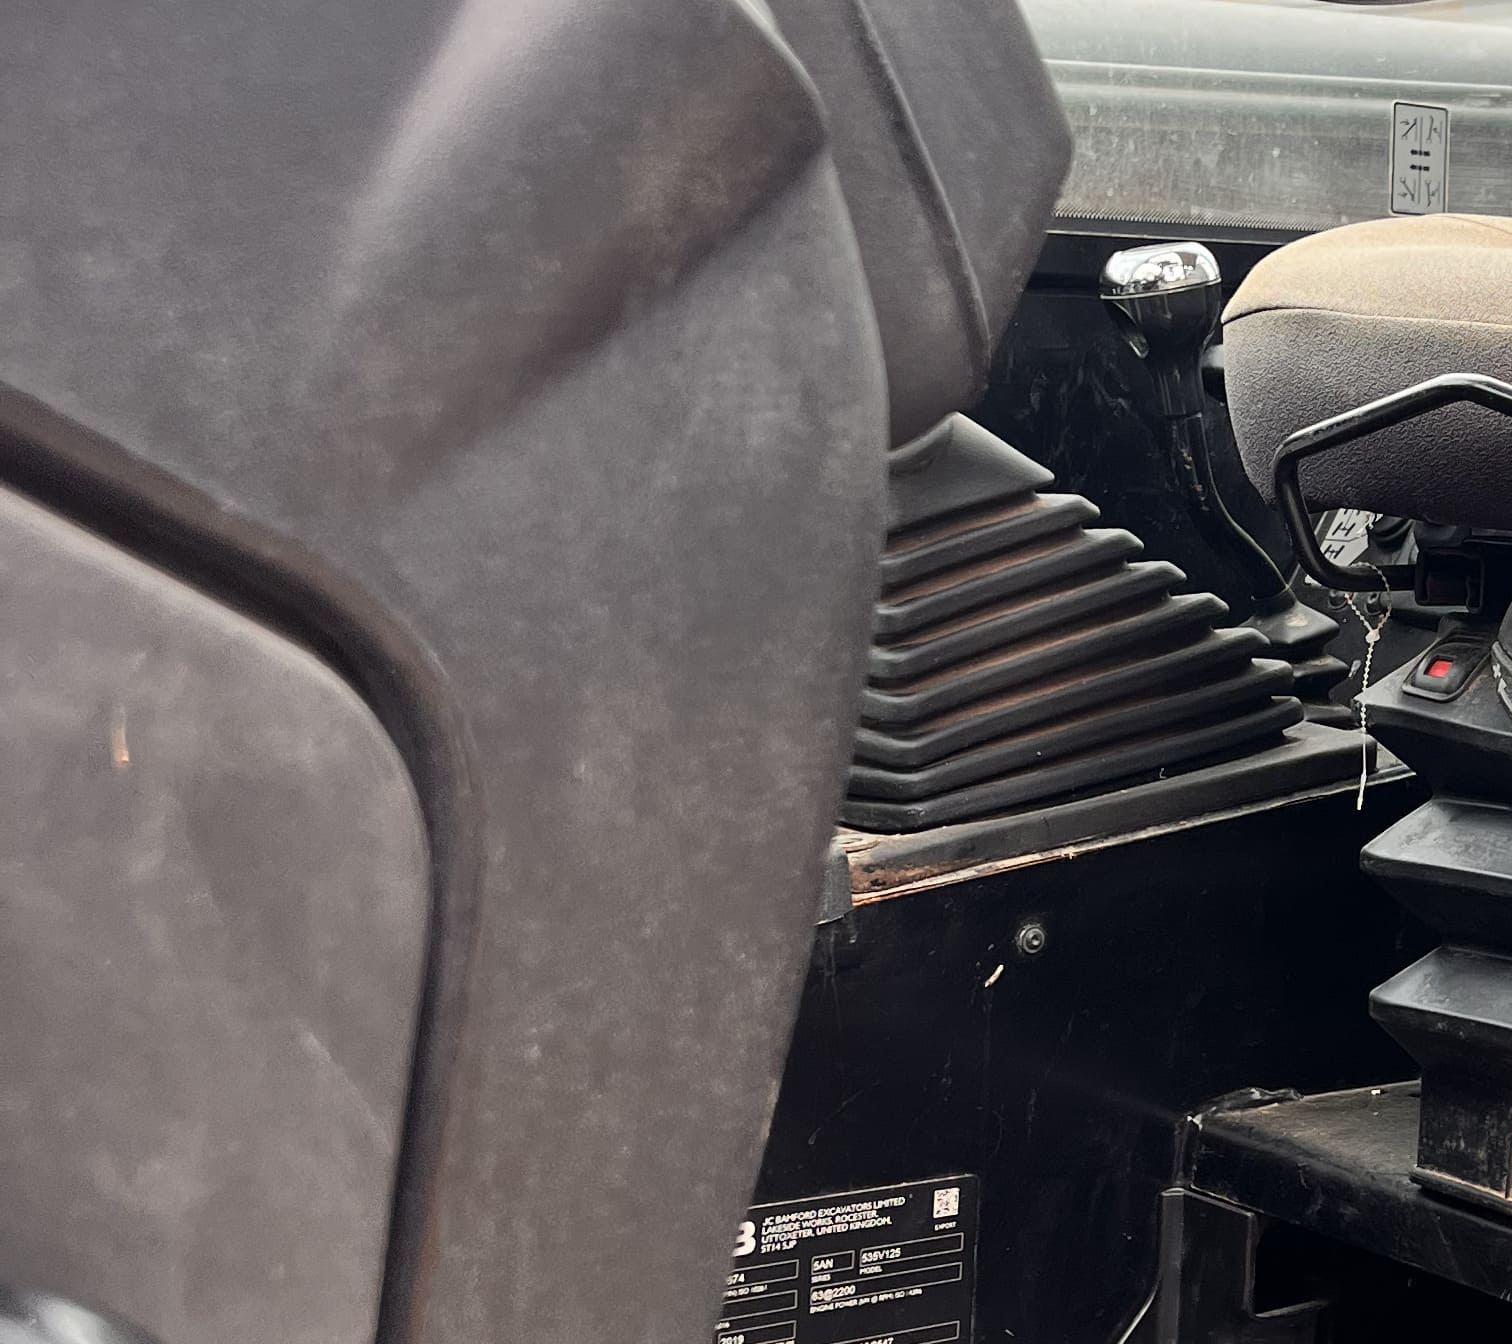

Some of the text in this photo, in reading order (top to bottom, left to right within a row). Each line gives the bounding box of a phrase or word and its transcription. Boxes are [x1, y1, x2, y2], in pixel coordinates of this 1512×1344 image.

[776, 1210, 815, 1224] BAMFORD
[817, 1201, 872, 1218] EXCAVATORS
[874, 1196, 904, 1209] LIMITED
[761, 1221, 799, 1235] LAKESIDE
[817, 1222, 848, 1235] UNITED
[861, 1247, 900, 1263] 535V125
[859, 1265, 882, 1275] MODEL
